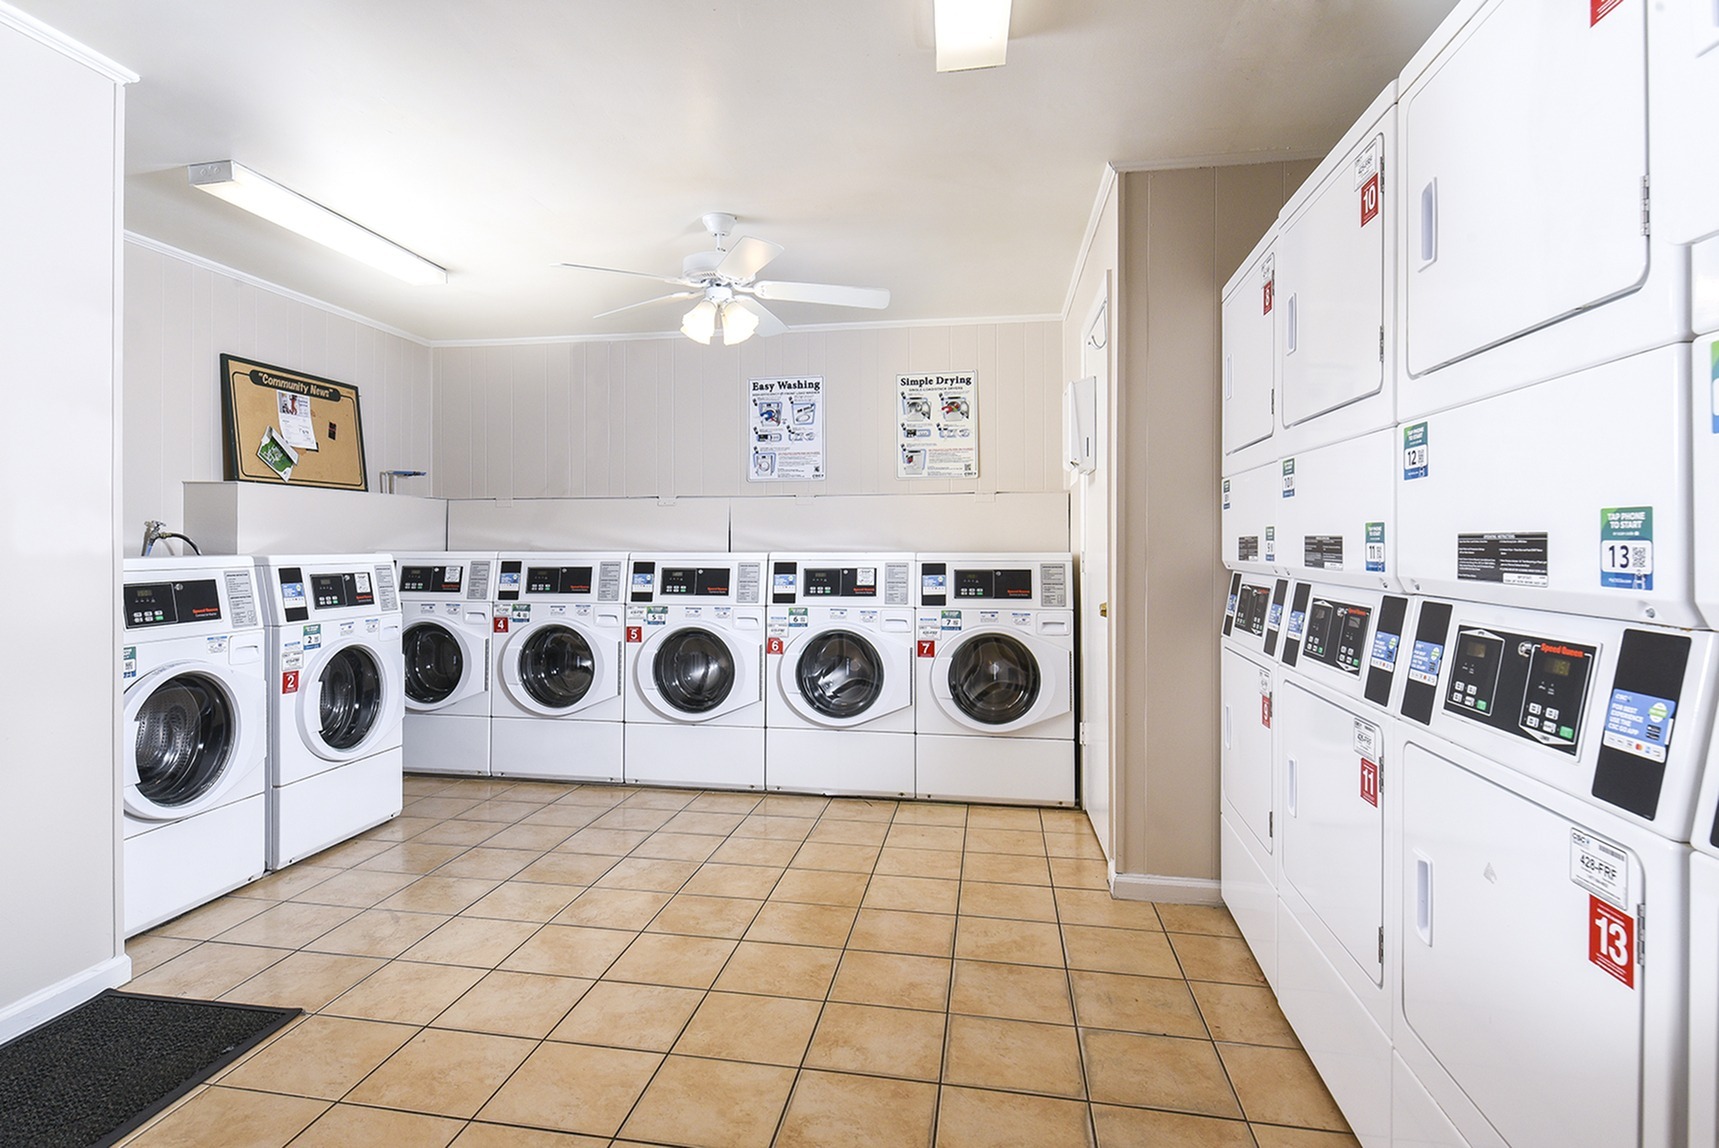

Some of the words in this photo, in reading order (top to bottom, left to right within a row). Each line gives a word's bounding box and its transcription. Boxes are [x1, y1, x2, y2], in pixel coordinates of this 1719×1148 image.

[1363, 185, 1376, 214] 10
[752, 382, 775, 393] Easy
[777, 380, 820, 391] Washing
[900, 377, 933, 388] Simple
[936, 376, 972, 387] Drying
[1407, 450, 1417, 466] 12
[1607, 512, 1620, 521] TAP
[1621, 511, 1646, 520] PHONE
[1609, 521, 1619, 529] TO
[1620, 520, 1643, 529] START
[1369, 545, 1376, 560] 11
[1608, 545, 1630, 568] 13
[498, 620, 504, 629] 4
[307, 636, 312, 644] 2
[630, 629, 638, 640] 5
[771, 641, 778, 651] 6
[922, 643, 930, 654] 7
[1541, 642, 1561, 655] Speed
[287, 675, 294, 688] 2
[1626, 727, 1640, 736] APP
[1362, 768, 1374, 796] 11
[1594, 915, 1628, 968] 13
